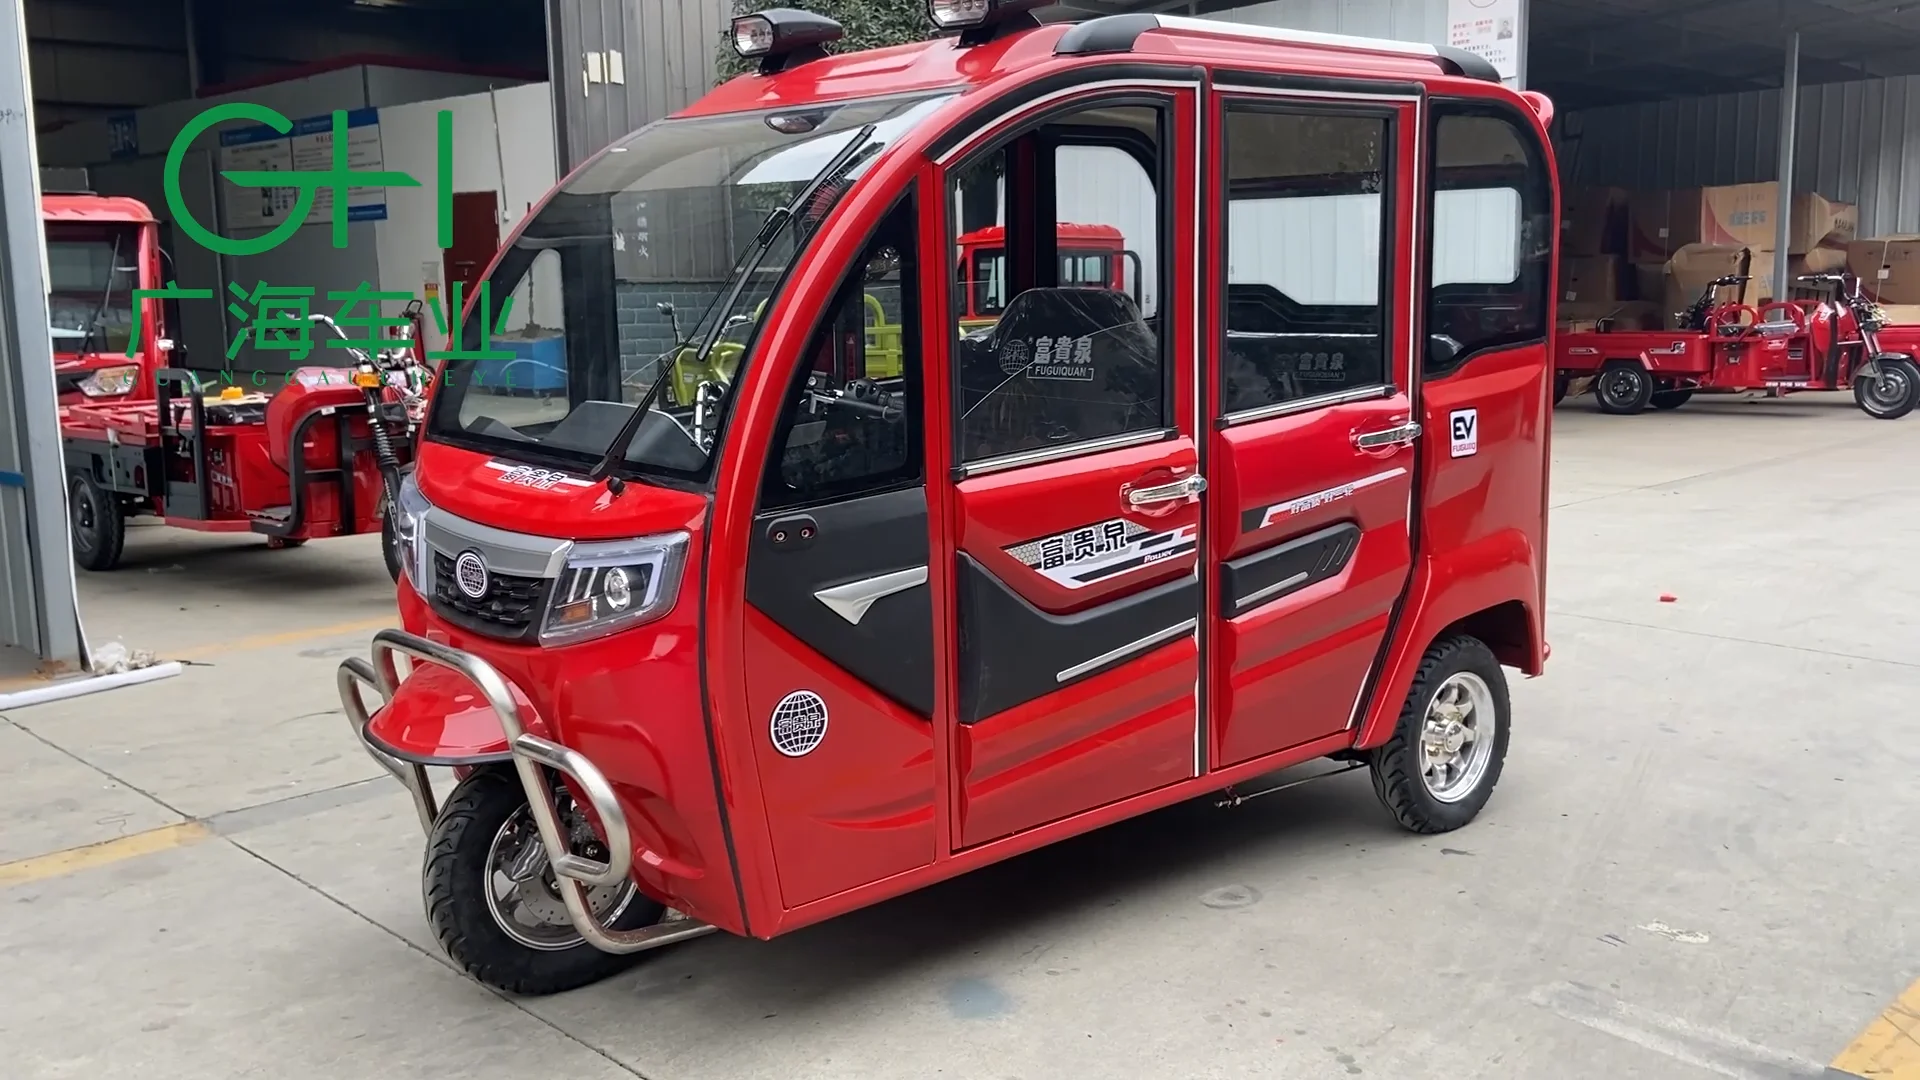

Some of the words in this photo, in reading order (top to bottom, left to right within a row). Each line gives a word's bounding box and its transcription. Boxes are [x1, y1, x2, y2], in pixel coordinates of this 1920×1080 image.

[1035, 366, 1087, 376] FUGUIQUAN
[1453, 415, 1475, 440] EV
[1040, 520, 1128, 570] 富贵泉
